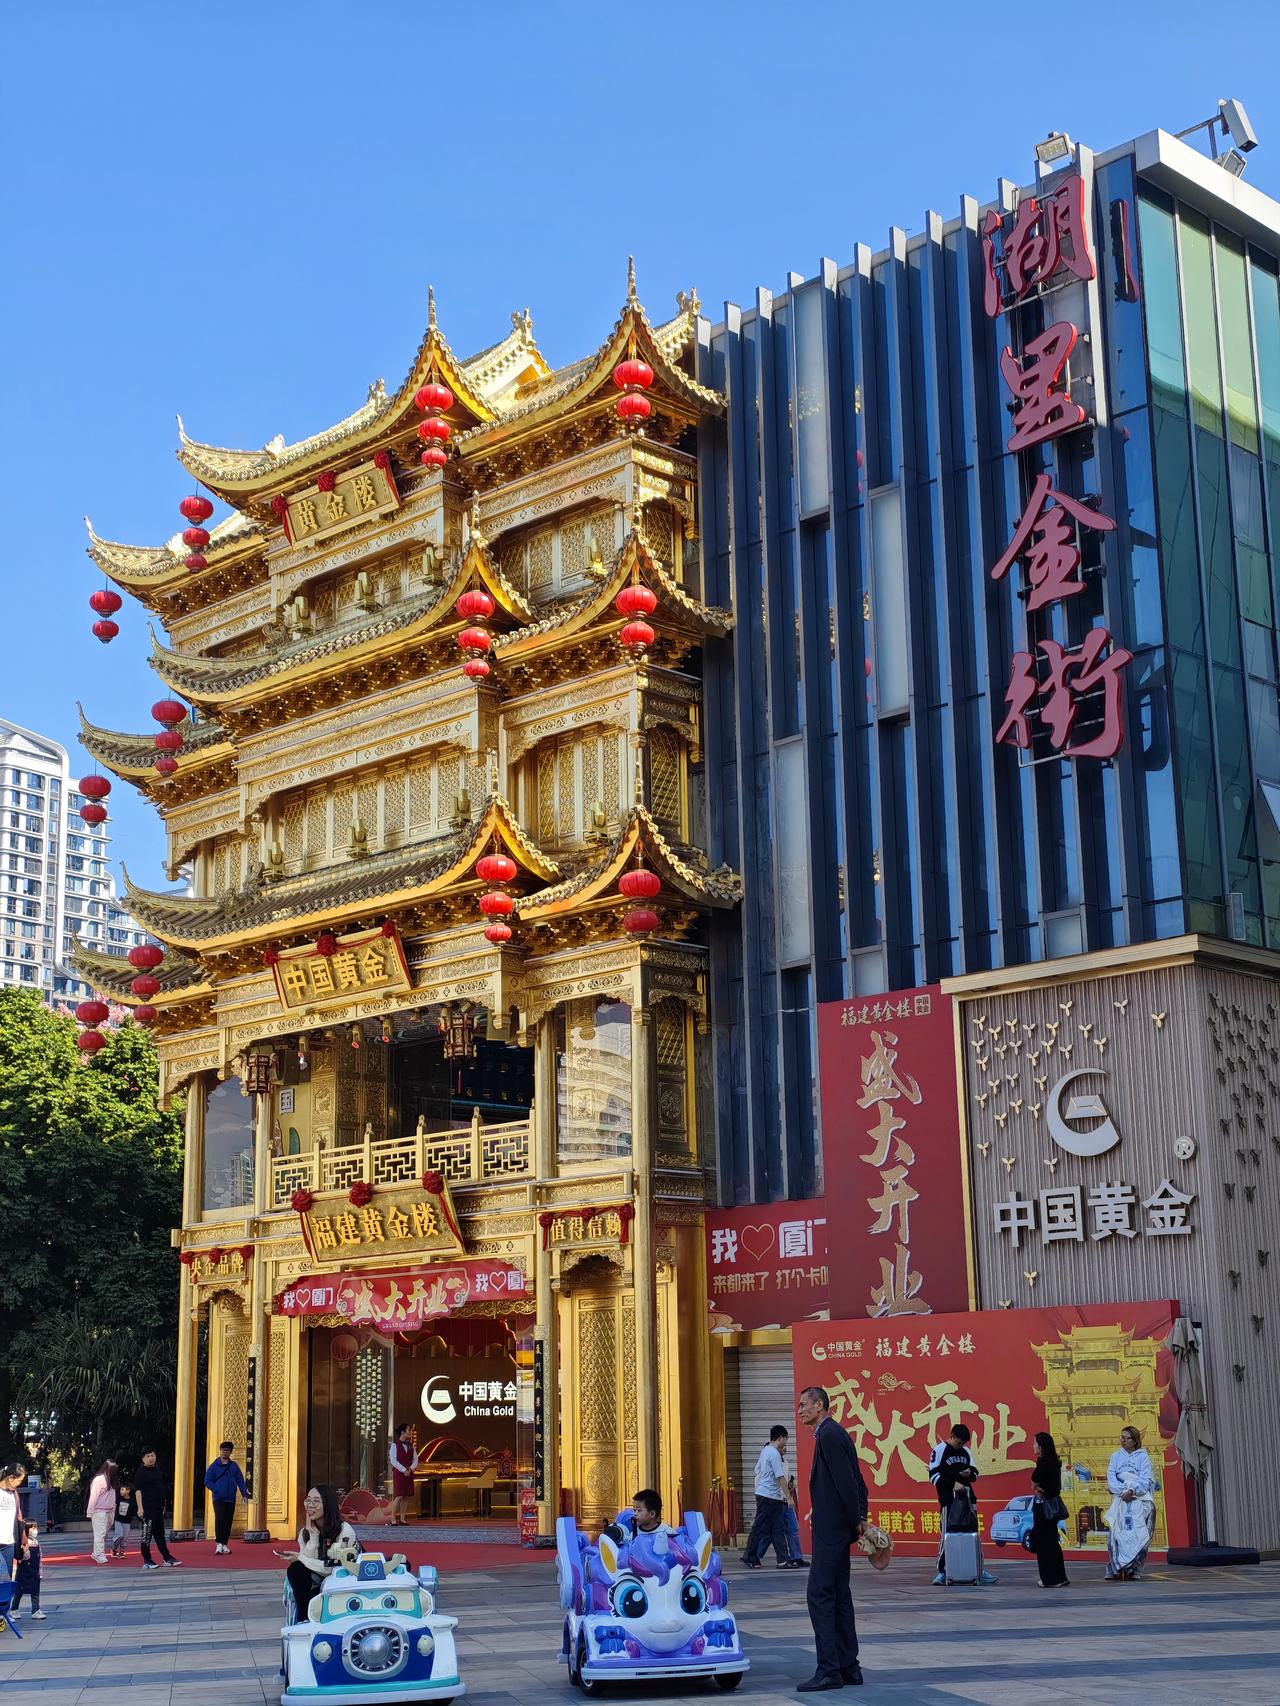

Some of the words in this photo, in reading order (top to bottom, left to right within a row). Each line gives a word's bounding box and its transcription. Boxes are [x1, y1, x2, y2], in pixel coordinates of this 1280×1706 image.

[982, 174, 1134, 760] 湖里金街
[284, 948, 388, 998] 中国黄金
[840, 996, 913, 1026] 福建黄金楼
[855, 1030, 934, 1319] 盛大开业
[312, 1202, 439, 1249] 福建黄金楼
[550, 1212, 622, 1241] 值得信赖
[993, 1178, 1195, 1248] 中国黄金
[711, 1228, 738, 1264] 我
[351, 1278, 448, 1323] 盛大开业
[827, 1341, 862, 1352] 中国黄金
[875, 1332, 976, 1358] 福建黄金楼
[458, 1381, 517, 1402] 中国黄金
[464, 1405, 491, 1417] China
[492, 1405, 514, 1416] Gold
[822, 1370, 1036, 1488] 盛大开业
[878, 1511, 916, 1533] 博黄金
